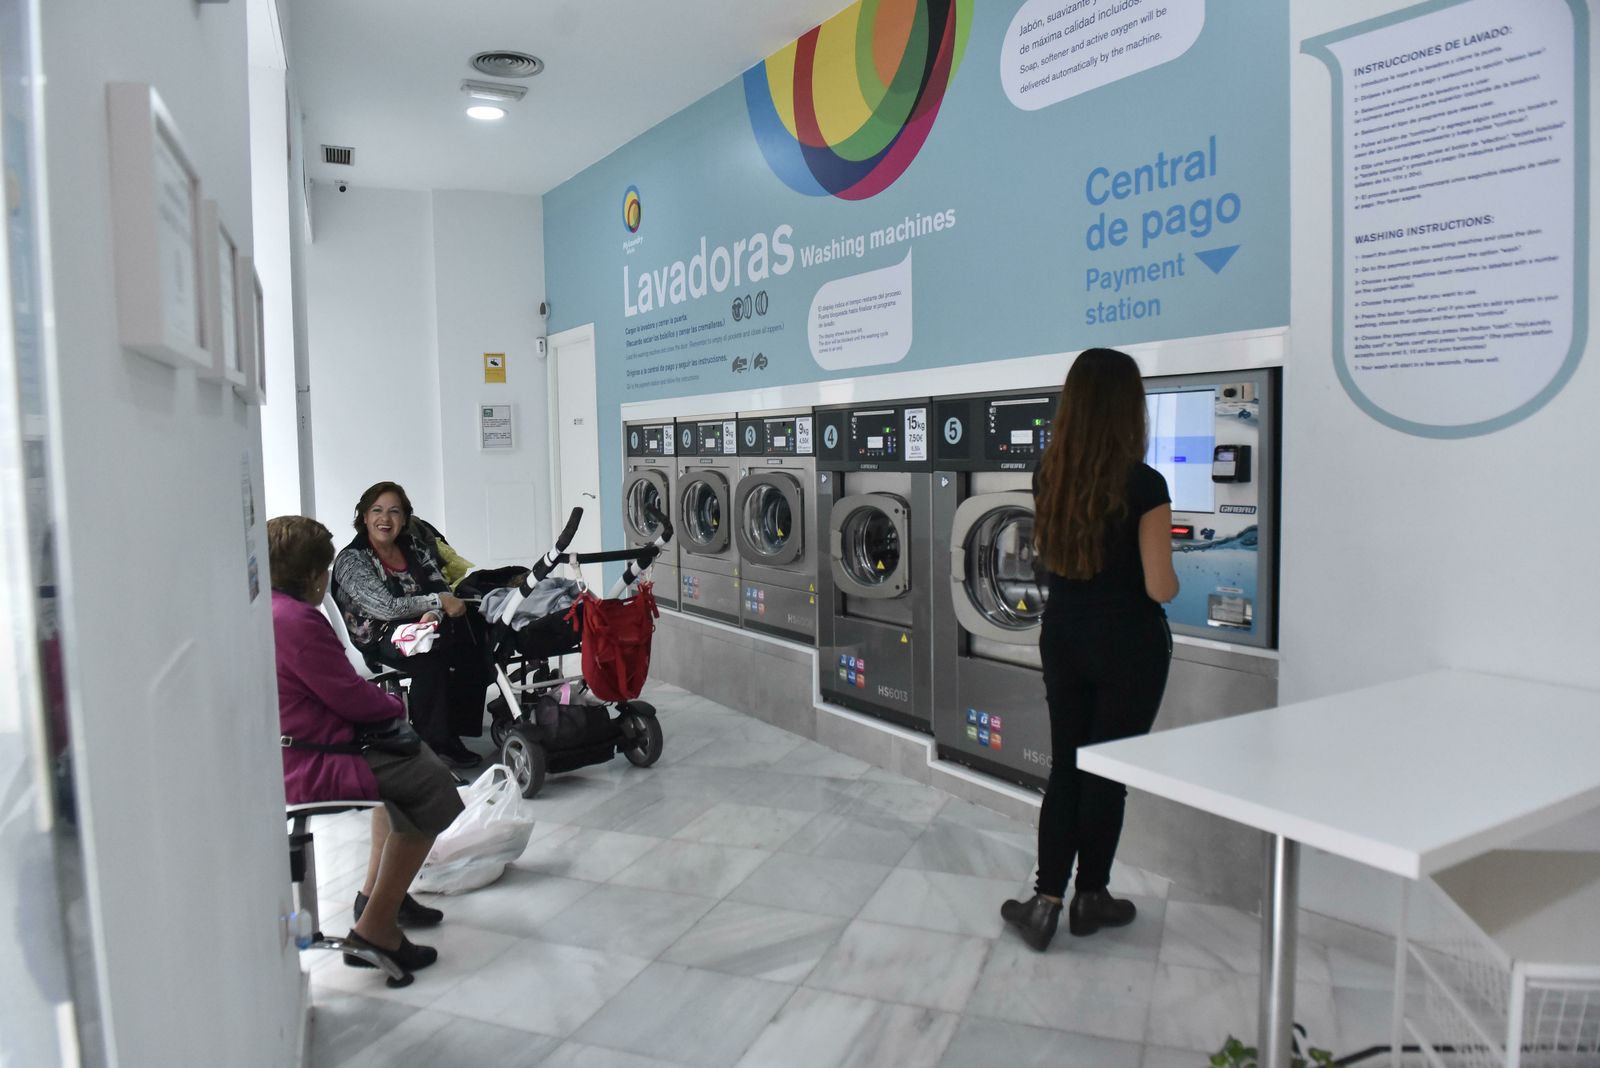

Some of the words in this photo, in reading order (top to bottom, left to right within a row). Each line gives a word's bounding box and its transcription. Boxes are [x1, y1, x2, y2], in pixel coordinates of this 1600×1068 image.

[1019, 18, 1045, 36] Jabón,
[1046, 0, 1090, 24] suavizante
[1020, 44, 1030, 55] de
[1032, 30, 1062, 50] máxima
[1064, 12, 1096, 36] calidad
[1020, 62, 1040, 74] Soap,
[1040, 48, 1069, 66] softener
[1070, 40, 1084, 53] and
[1086, 32, 1108, 46] active
[1110, 20, 1138, 36] oxygen
[1140, 10, 1154, 24] will
[1156, 8, 1168, 18] be
[1020, 74, 1050, 94] delivered
[1052, 56, 1098, 81] automatically
[1100, 52, 1110, 63] by
[1111, 46, 1124, 58] the
[1126, 32, 1162, 51] machine.
[1354, 44, 1442, 77] INSTRUCCIONES
[1444, 39, 1460, 52] DE
[1464, 26, 1512, 46] LAVADO:
[1086, 134, 1216, 206] Central
[1086, 212, 1128, 251] de
[1142, 192, 1242, 249] pago
[1354, 228, 1404, 244] WASHING
[1406, 214, 1495, 236] INSTRUCTIONS:
[623, 224, 795, 318] Lavadoras
[800, 236, 865, 268] Washing
[870, 208, 956, 250] machines
[1086, 252, 1186, 292] Payment
[1086, 297, 1162, 326] station
[748, 429, 753, 444] 3
[799, 423, 809, 436] 9kg
[827, 429, 835, 445] 4
[907, 415, 925, 431] 15kg
[949, 420, 957, 440] 5
[684, 431, 689, 446] 2
[878, 685, 908, 702] HS6013
[1023, 748, 1053, 769] HS60
